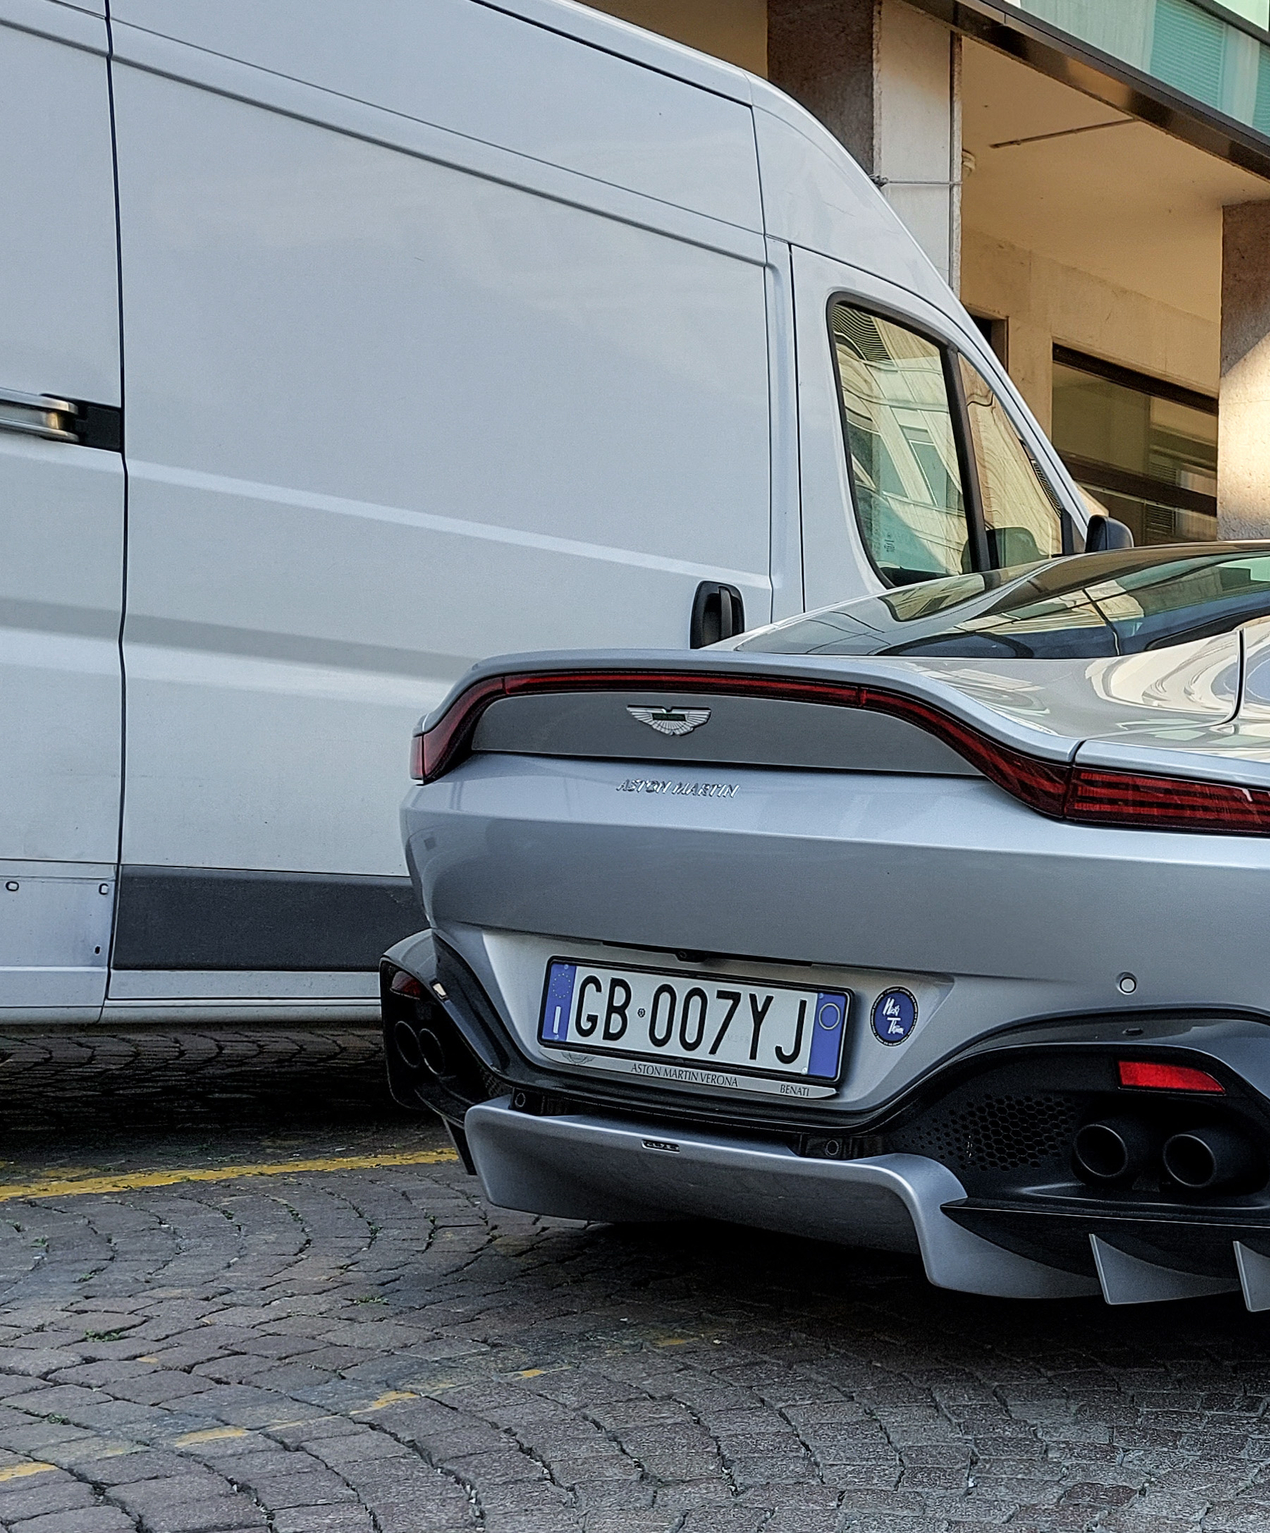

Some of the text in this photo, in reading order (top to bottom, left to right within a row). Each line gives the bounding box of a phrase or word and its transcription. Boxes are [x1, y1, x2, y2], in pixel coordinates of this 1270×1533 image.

[616, 778, 741, 799] ASTON MARTIN
[574, 974, 633, 1042] GB
[648, 983, 808, 1065] 007YJ
[630, 1063, 810, 1097] ASTON MARTIN VERONA BENATI
